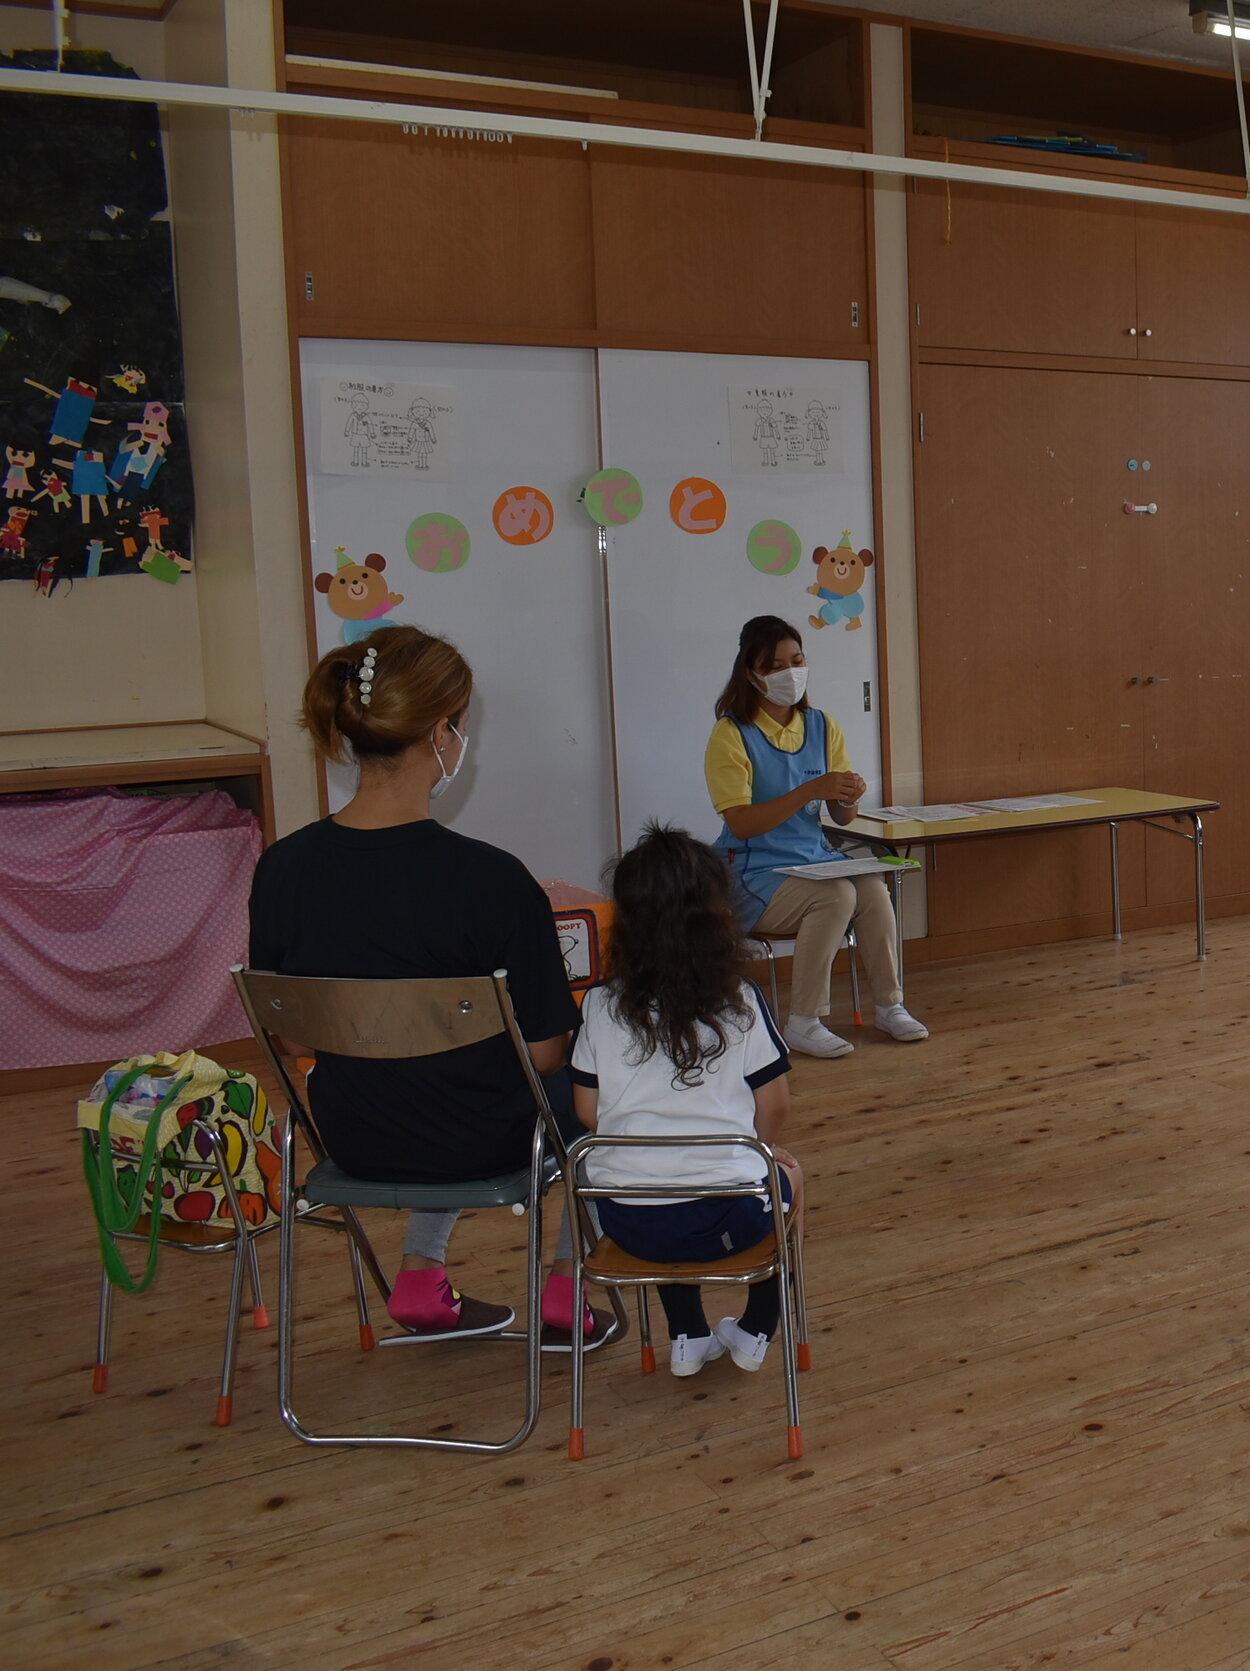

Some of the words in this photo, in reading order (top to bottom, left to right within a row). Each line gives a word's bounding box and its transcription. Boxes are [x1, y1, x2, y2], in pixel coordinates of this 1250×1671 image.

[412, 476, 793, 572] おめでとう
